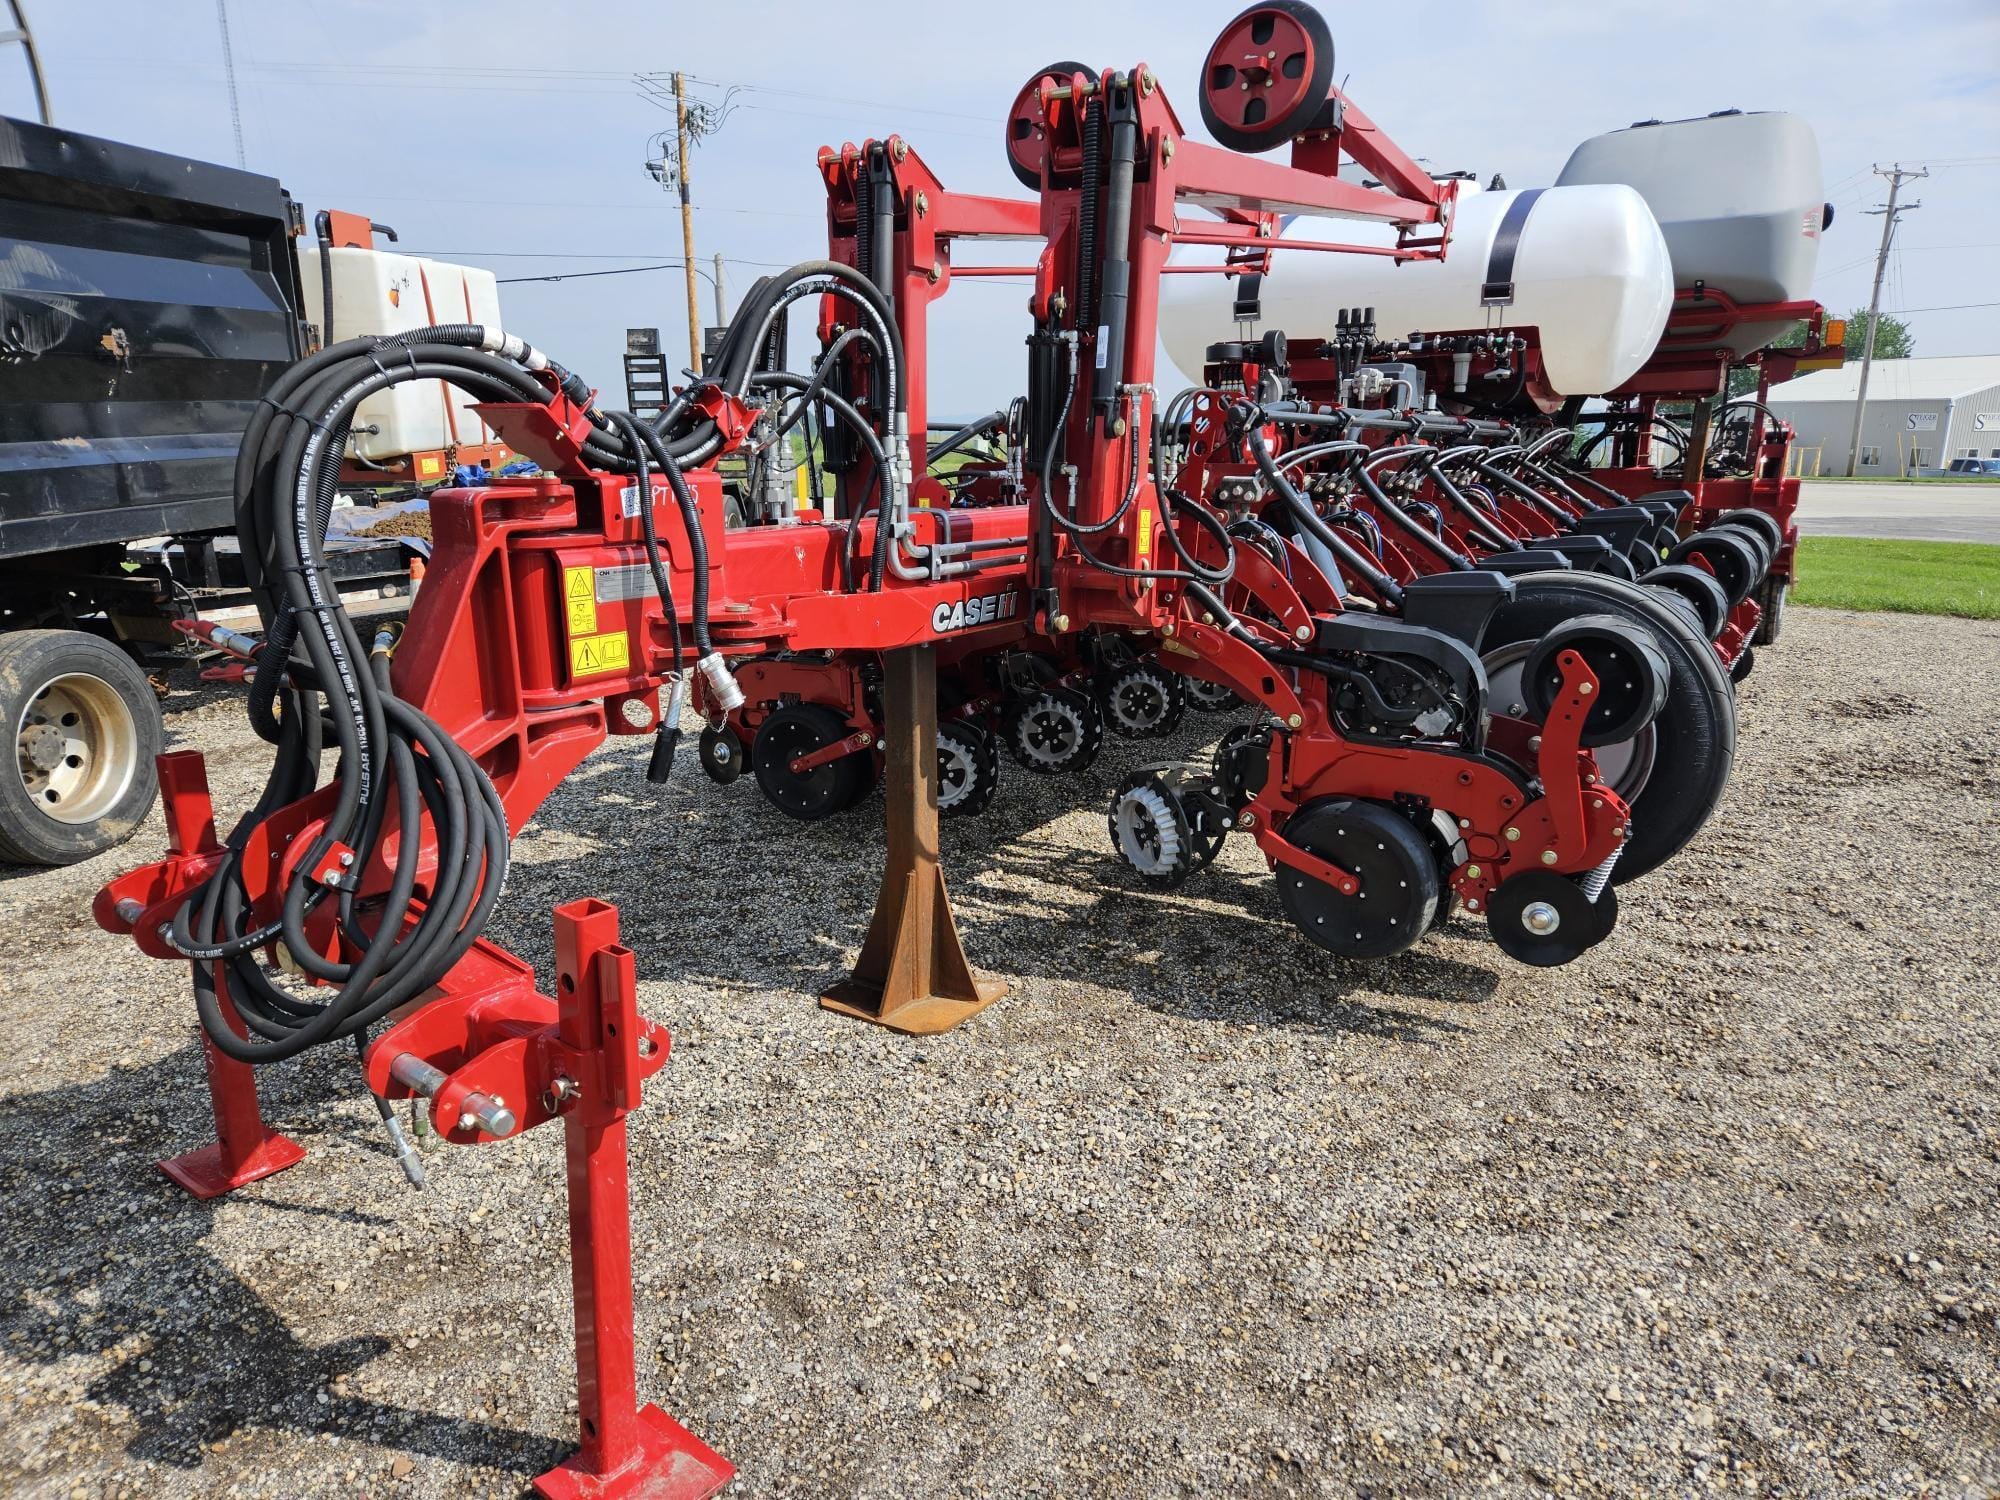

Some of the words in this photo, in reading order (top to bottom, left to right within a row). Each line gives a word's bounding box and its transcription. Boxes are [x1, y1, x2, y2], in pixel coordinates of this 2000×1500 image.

[301, 454, 313, 470] 2SC
[296, 507, 306, 522] SAE
[298, 529, 312, 559] 100R17
[303, 560, 315, 576] SE
[307, 575, 325, 607] EXCEEDS
[318, 610, 330, 624] WP
[932, 595, 998, 632] CASE
[323, 624, 337, 641] BAR
[329, 641, 343, 657] 250
[337, 661, 351, 674] PSI
[360, 752, 371, 805] PULSAR
